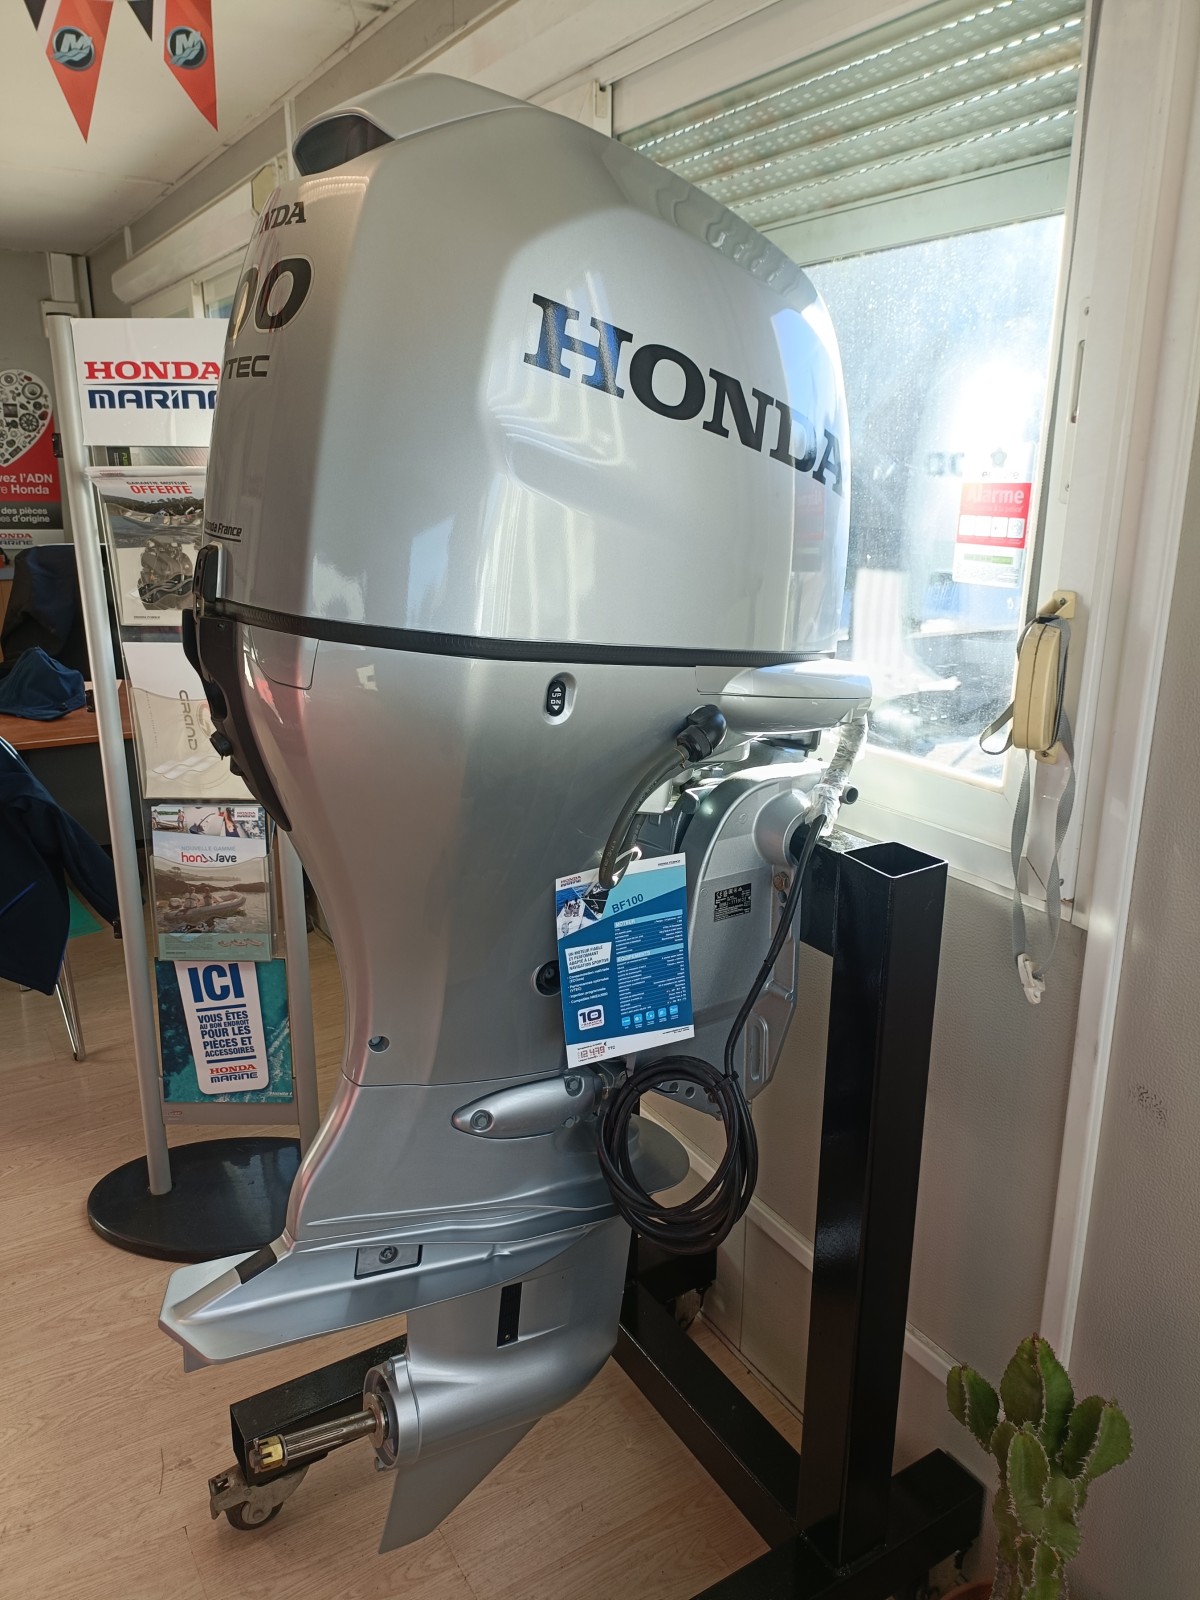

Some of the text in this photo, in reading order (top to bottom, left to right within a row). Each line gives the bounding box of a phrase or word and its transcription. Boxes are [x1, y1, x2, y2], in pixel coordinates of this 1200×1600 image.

[255, 201, 307, 236] NDA
[84, 361, 220, 380] HONDA
[223, 355, 270, 379] TEC
[523, 293, 844, 496] HONDA
[20, 473, 53, 483] l'ADN
[11, 484, 50, 494] Honda
[1, 506, 48, 516] des pièces
[218, 523, 242, 537] France
[179, 690, 198, 751] GRAND
[612, 893, 644, 913] BF100
[188, 963, 245, 1003] ICI
[198, 1010, 249, 1023] VOUS ÊTES
[579, 1009, 602, 1023] 10
[224, 1019, 250, 1028] ENDROIT
[201, 1025, 251, 1039] POUR LES
[203, 1036, 253, 1050] PIÈCES ET
[205, 1046, 255, 1058] ACCESSOIRES
[209, 1064, 257, 1075] HONDA
